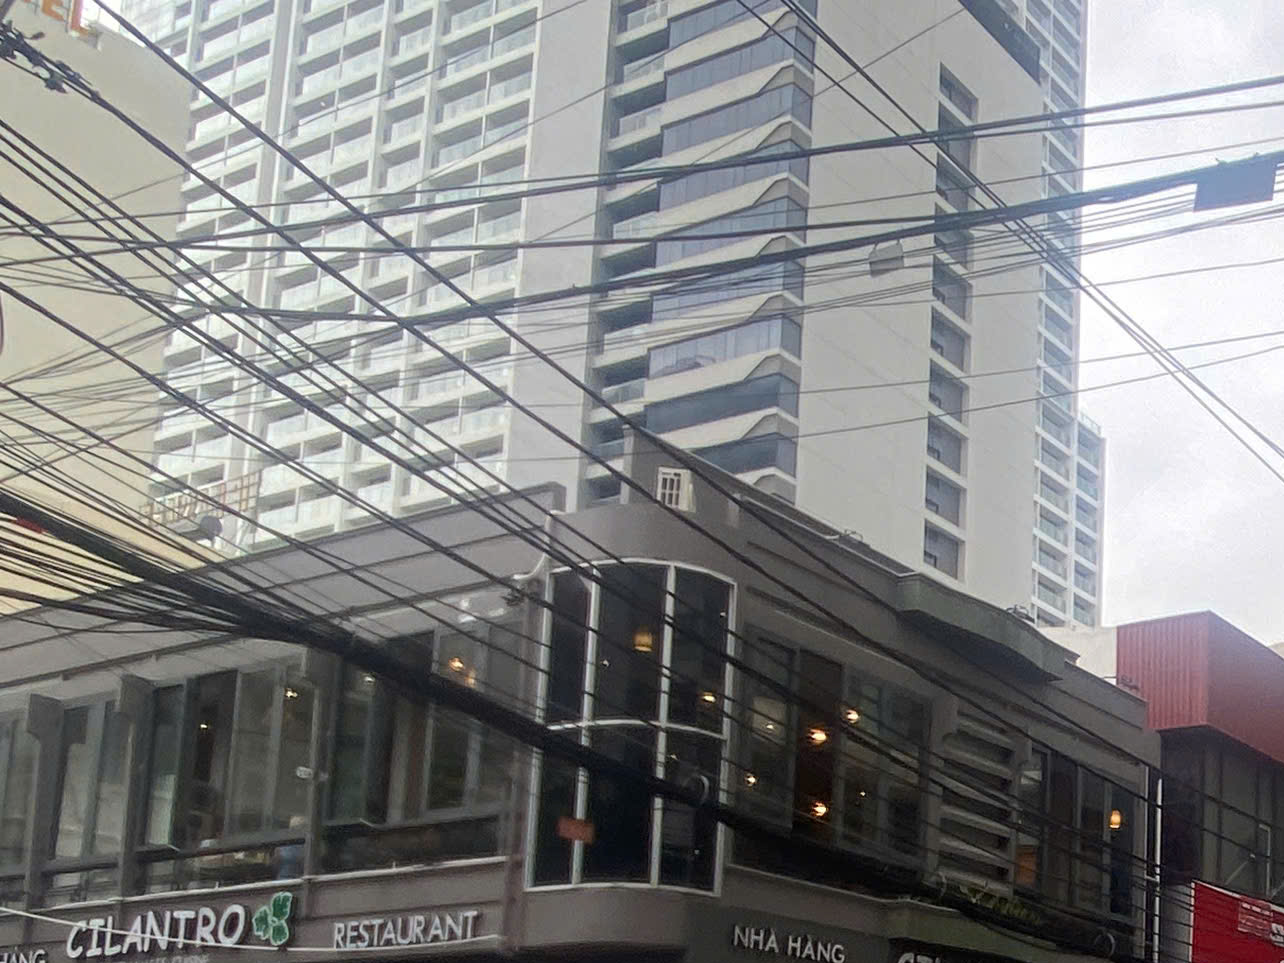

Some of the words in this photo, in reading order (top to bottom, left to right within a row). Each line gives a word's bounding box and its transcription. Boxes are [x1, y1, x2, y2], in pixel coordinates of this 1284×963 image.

[66, 903, 246, 960] CILANTRO
[333, 910, 478, 949] RESTAURANT
[734, 925, 779, 953] NHÀ
